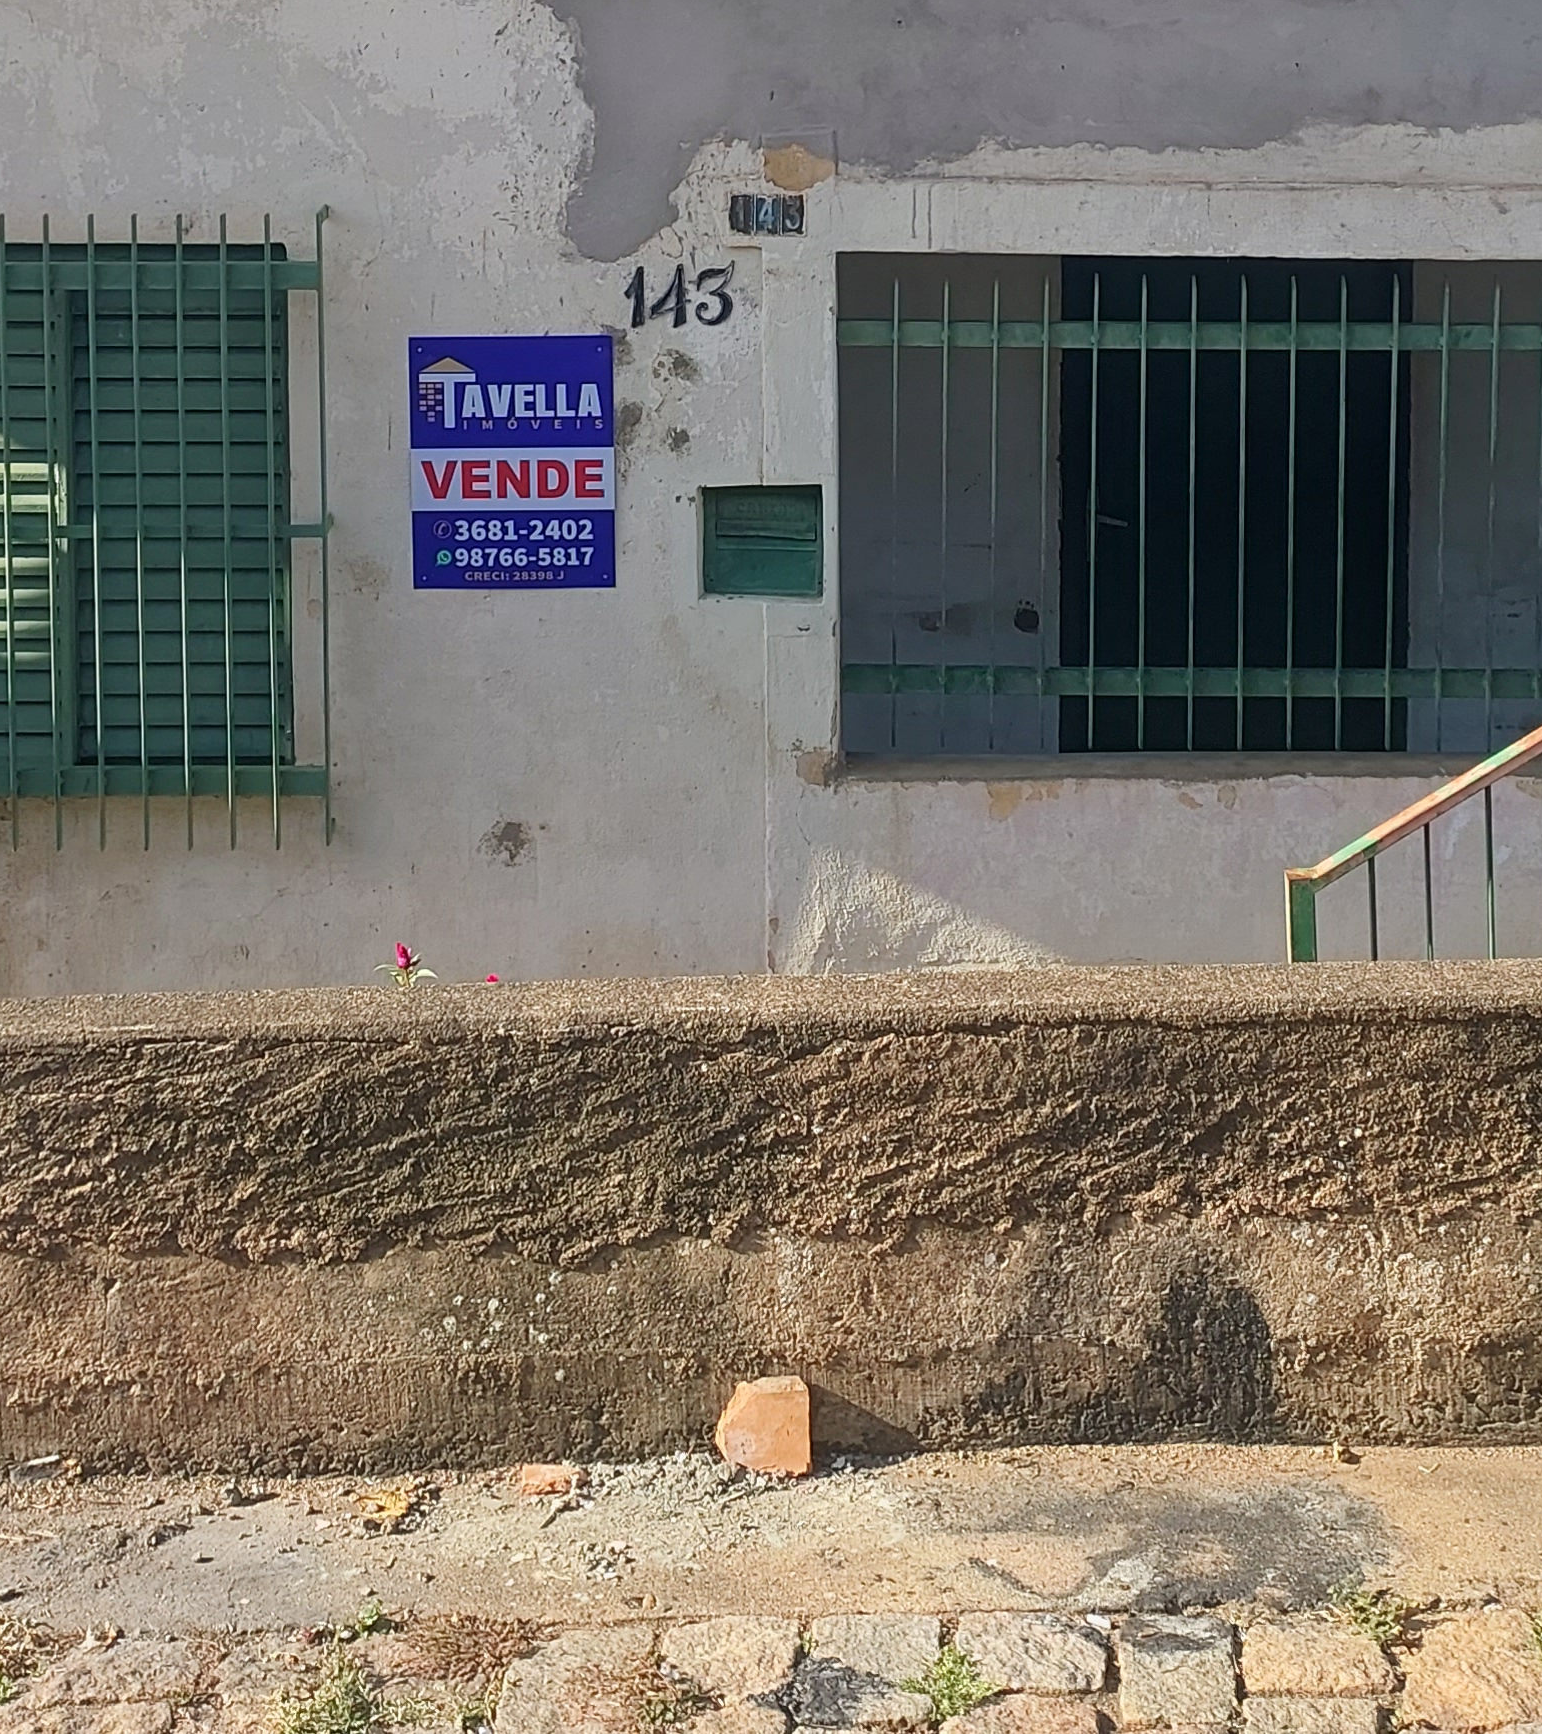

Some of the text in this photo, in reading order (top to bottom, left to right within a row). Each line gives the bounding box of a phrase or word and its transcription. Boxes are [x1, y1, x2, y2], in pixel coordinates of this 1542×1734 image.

[733, 194, 802, 232] 143
[624, 260, 735, 328] 143
[418, 372, 602, 429] TAVELLA
[463, 416, 604, 430] IMÓVEIS
[421, 459, 605, 499] VENDE
[454, 519, 594, 541] 3681-2402
[454, 547, 594, 567] 98766-5817
[464, 570, 564, 581] CRECI: 28398 J
